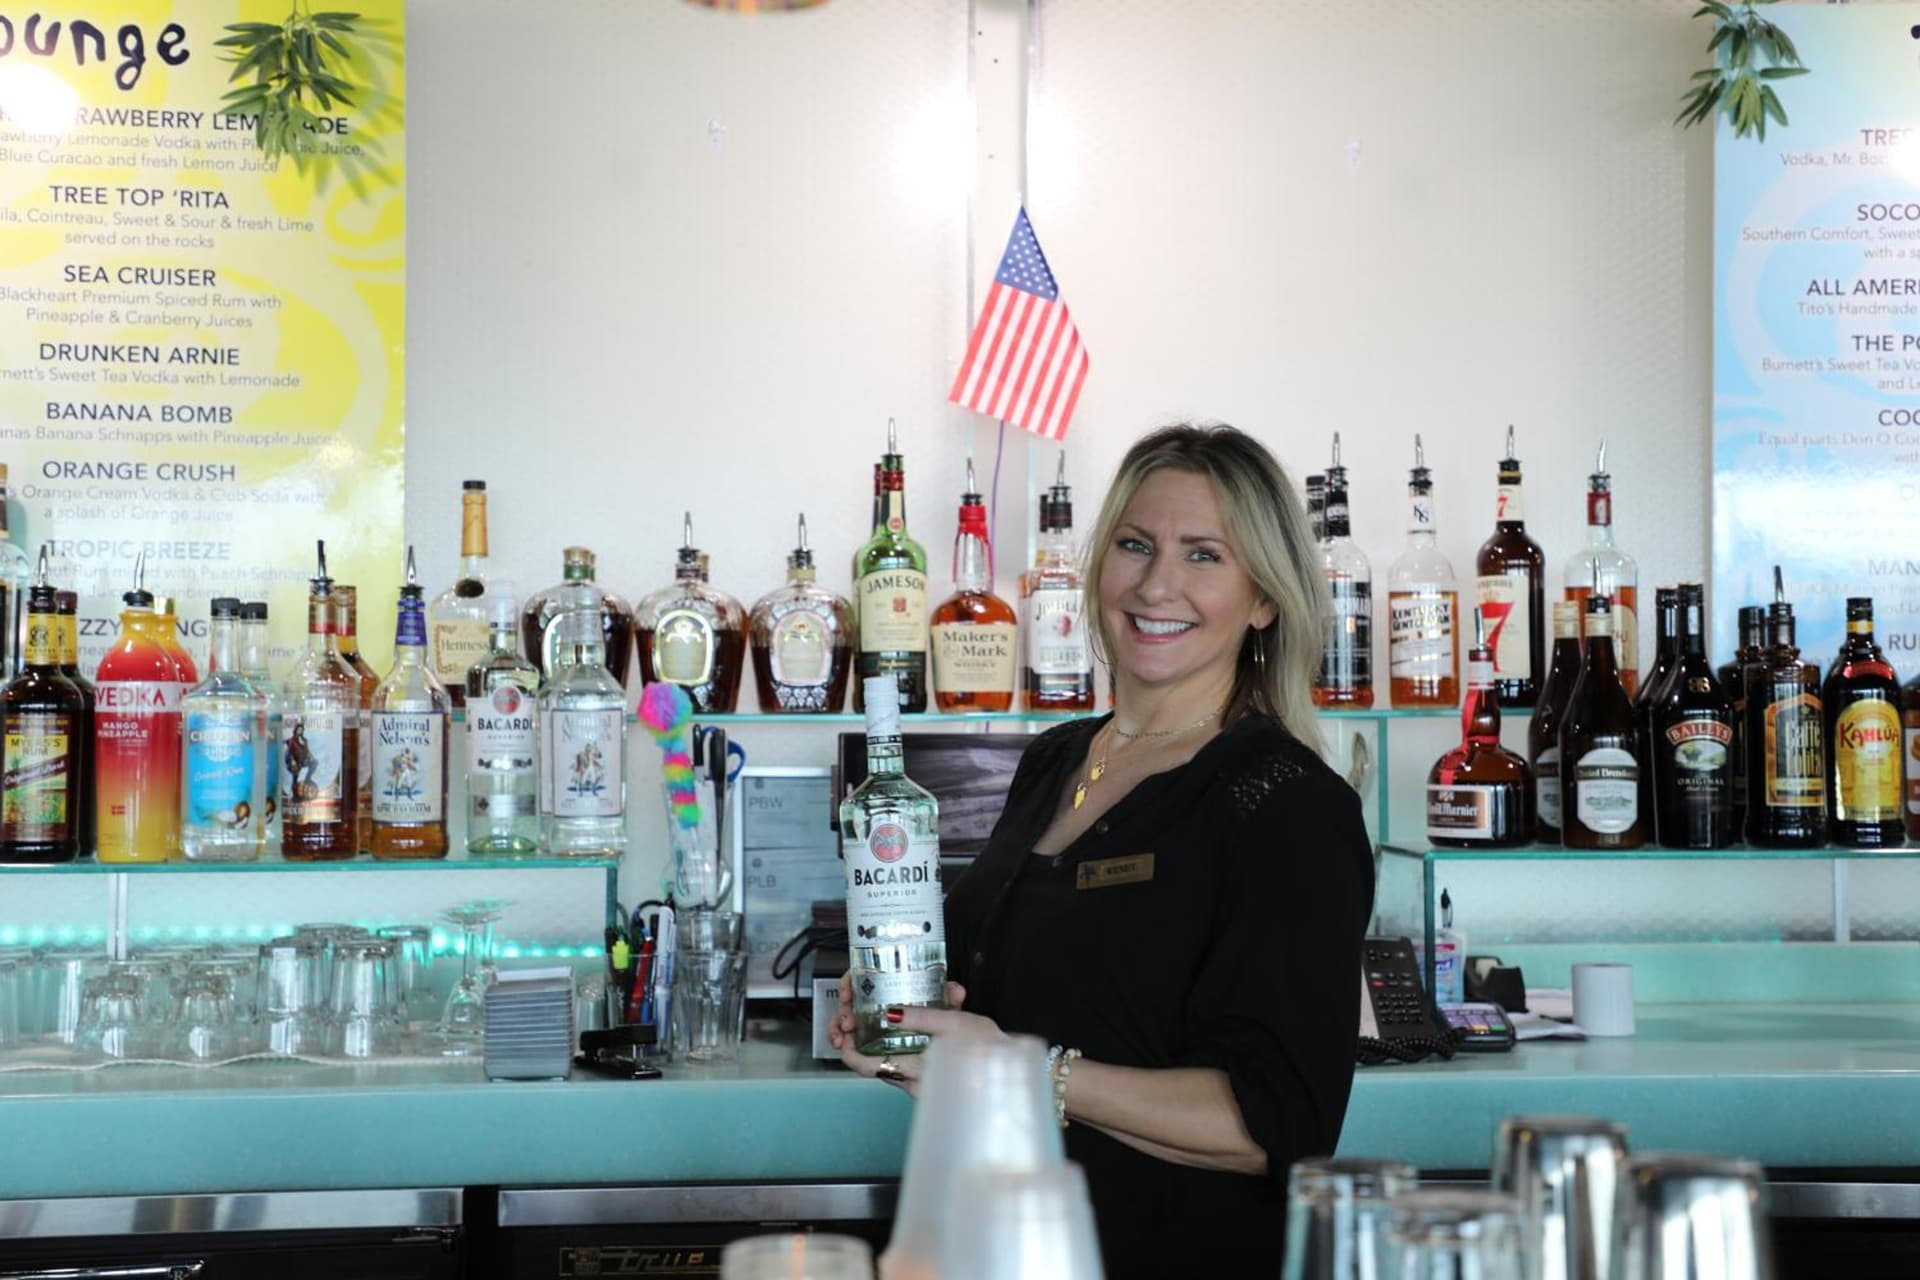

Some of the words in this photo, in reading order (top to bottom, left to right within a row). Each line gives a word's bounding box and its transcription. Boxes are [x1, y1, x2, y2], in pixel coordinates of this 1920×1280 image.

[67, 131, 149, 148] Lemonade
[153, 133, 202, 151] Vodka
[204, 135, 237, 151] with
[37, 150, 103, 166] Curacao
[106, 152, 137, 167] and
[141, 153, 178, 169] fresh
[183, 156, 235, 171] Lemon
[49, 184, 108, 206] TREE
[115, 186, 164, 207] TOP
[172, 189, 229, 209] 'RITA
[27, 209, 109, 227] Cointreau,
[113, 212, 160, 228] Sweet
[164, 213, 176, 228] &
[181, 213, 216, 229] Sour
[220, 214, 233, 230] &
[236, 215, 273, 231] fresh
[277, 217, 315, 233] Lime
[1856, 203, 1920, 222] SOCO
[64, 230, 117, 246] served
[122, 233, 140, 247] on
[144, 232, 170, 248] the
[174, 233, 215, 249] rocks
[1742, 226, 1808, 242] Southern
[1863, 246, 1893, 260] with
[63, 264, 109, 284] SEA
[117, 266, 217, 288] CRUISER
[1806, 278, 1846, 296] ALL
[82, 288, 151, 305] Premium
[155, 291, 208, 310] Spiced
[212, 294, 247, 310] Rum
[250, 294, 283, 310] with
[1838, 301, 1918, 316] Handmade
[25, 307, 105, 326] Pineapple
[108, 309, 121, 323] &
[125, 310, 201, 329] Cranberry
[205, 312, 253, 329] Juices
[1850, 334, 1895, 352] THE
[38, 342, 160, 364] DRUNKEN
[168, 346, 241, 366] ARNIE
[1827, 357, 1873, 372] Sweet
[48, 368, 98, 384] Sweet
[101, 369, 128, 384] Tea
[132, 370, 179, 386] Vodka
[183, 371, 215, 387] with
[219, 372, 301, 388] Lemonade
[46, 402, 153, 423] BANANA
[160, 404, 234, 425] BOMB
[35, 427, 95, 443] Banana
[98, 428, 173, 448] Schnapps
[176, 429, 208, 444] with
[212, 429, 289, 448] Pineapple
[42, 460, 148, 480] ORANGE
[155, 462, 236, 482] CRUSH
[22, 485, 82, 503] Orange
[86, 486, 139, 501] Cream
[142, 487, 190, 502] Vodka
[144, 541, 232, 560] BREEZE
[866, 574, 926, 595] JAMESON
[943, 630, 1009, 643] Maker's
[1888, 632, 1920, 651] RU
[961, 644, 1008, 657] Mark
[1670, 722, 1730, 741] BAILEYS
[854, 860, 929, 887] BACARDÍ
